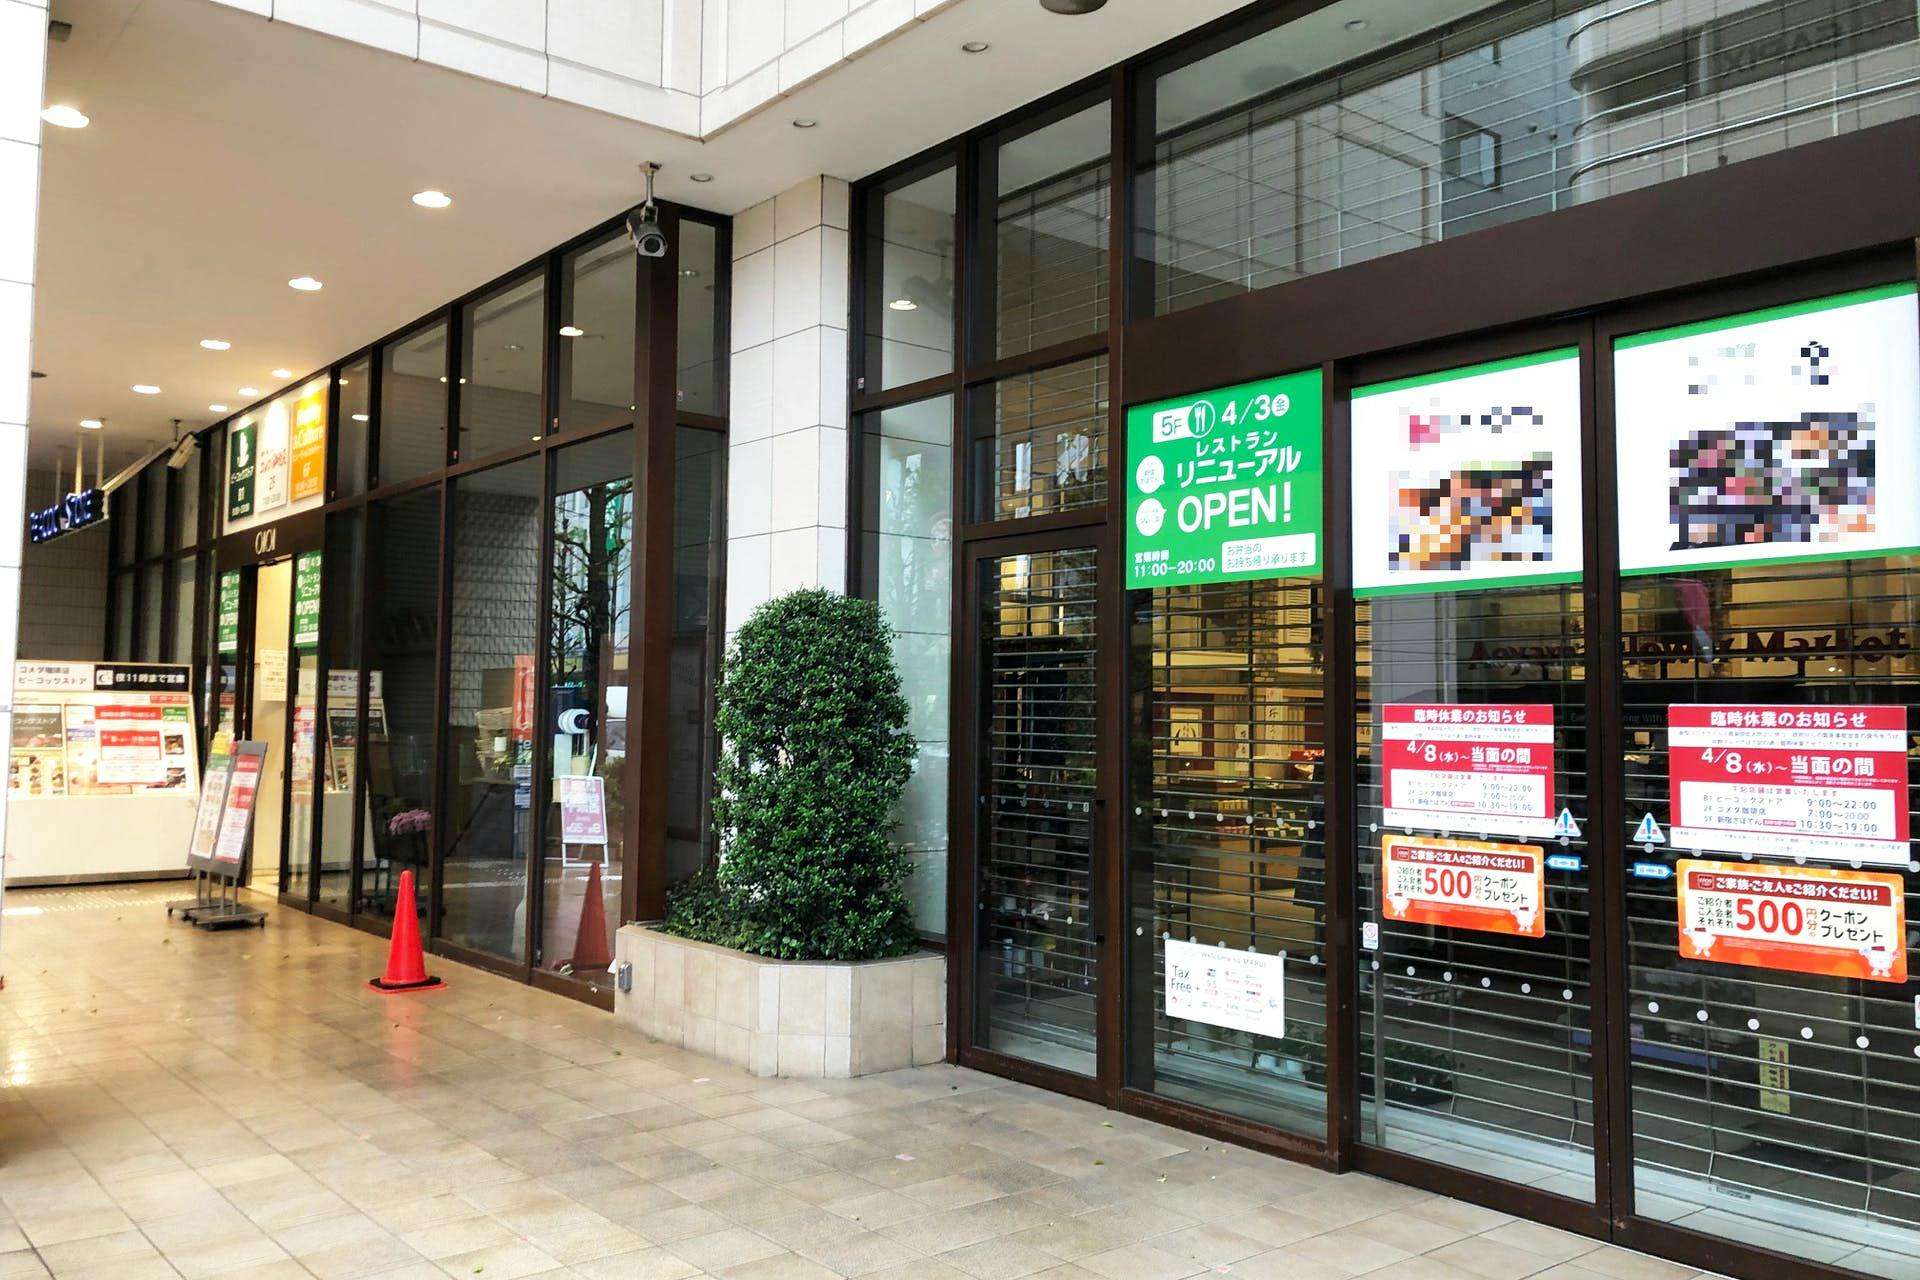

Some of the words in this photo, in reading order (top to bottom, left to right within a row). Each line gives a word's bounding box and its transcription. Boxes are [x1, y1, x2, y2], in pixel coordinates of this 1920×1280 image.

[1161, 415, 1182, 436] 5F
[1221, 395, 1270, 426] 4/3
[1196, 430, 1278, 458] レストラン
[1177, 445, 1301, 488] リニューアル
[1177, 481, 1292, 533] OPEN!
[1135, 550, 1170, 565] 営業時間
[1469, 640, 1578, 676] Aoyam
[1745, 627, 1911, 663] Market
[1414, 709, 1527, 725] 臨時休業のお知らせ
[1710, 711, 1868, 728] 臨時休業のお知らせ
[1424, 867, 1472, 899] 500
[1483, 875, 1518, 890] クーポン
[1483, 888, 1529, 904] プレゼント
[1736, 897, 1804, 936] 500
[1820, 908, 1869, 926] クーポン
[1820, 924, 1884, 945] プレゼント
[1172, 964, 1190, 980] Tax
[1170, 977, 1193, 994] Free
